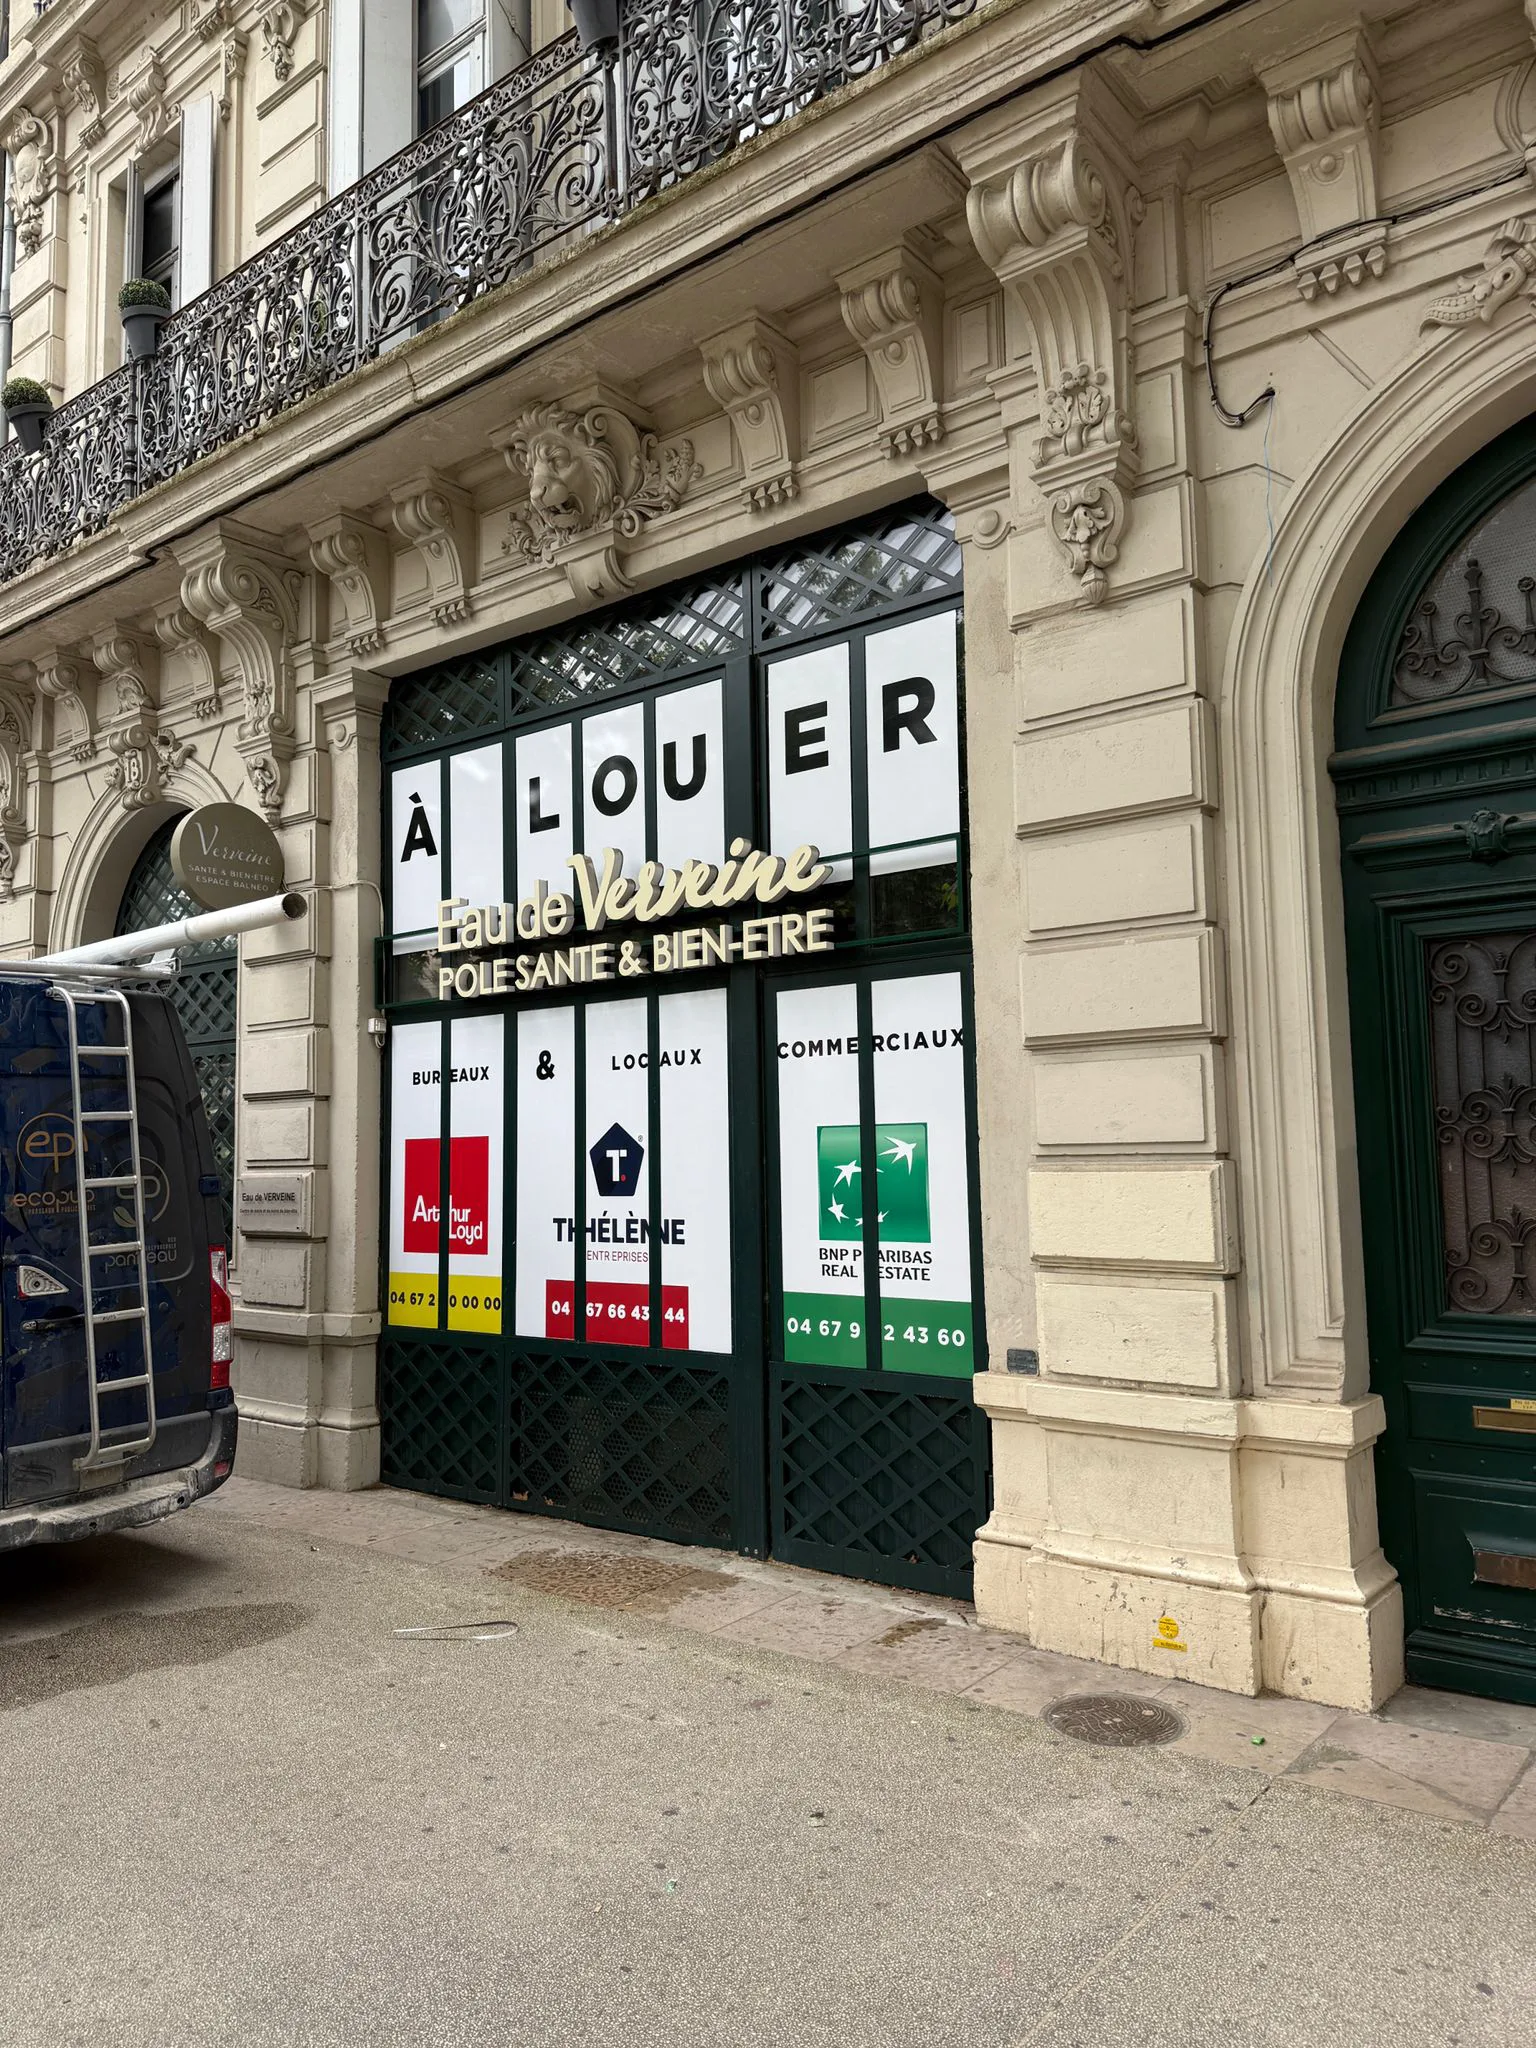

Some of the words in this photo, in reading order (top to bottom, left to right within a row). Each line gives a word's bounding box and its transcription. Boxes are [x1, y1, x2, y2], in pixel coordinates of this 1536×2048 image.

[400, 792, 438, 862] À
[529, 676, 938, 834] LOUER
[194, 822, 272, 865] Verveine
[188, 864, 217, 875] SANTE
[196, 876, 230, 887] ESPACE
[233, 879, 269, 891] BALNEO
[437, 896, 514, 952] Eau
[517, 879, 575, 940] de
[566, 836, 833, 931] Verveine
[439, 958, 515, 1000] POLE
[515, 942, 615, 990] SANTE
[618, 940, 649, 977] &
[652, 909, 834, 972] BIEN-ETRE
[413, 1066, 489, 1085] BUREAUX
[536, 1050, 555, 1080] &
[612, 1048, 702, 1071] LOCAUX
[777, 1028, 964, 1060] COMMERCIAUX
[242, 1193, 253, 1201] Eau
[255, 1193, 262, 1201] de
[264, 1192, 295, 1201] VERVEINE
[412, 1195, 471, 1222] Arthur
[449, 1221, 483, 1245] Loyd
[819, 1248, 849, 1261] BNP
[853, 1249, 932, 1264] PARIBAS
[821, 1264, 858, 1278] REAL
[878, 1266, 931, 1281] ESTATE
[390, 1291, 405, 1304] 04
[410, 1293, 424, 1305] 67
[461, 1295, 479, 1309] 00
[484, 1296, 501, 1311] 00
[551, 1301, 570, 1316] 04
[585, 1302, 603, 1317] 67
[607, 1304, 626, 1319] 66
[630, 1305, 650, 1321] 43
[664, 1307, 685, 1323] 44
[787, 1317, 812, 1335] 04
[819, 1319, 841, 1337] 67
[903, 1326, 929, 1344] 43
[937, 1328, 965, 1347] 60
